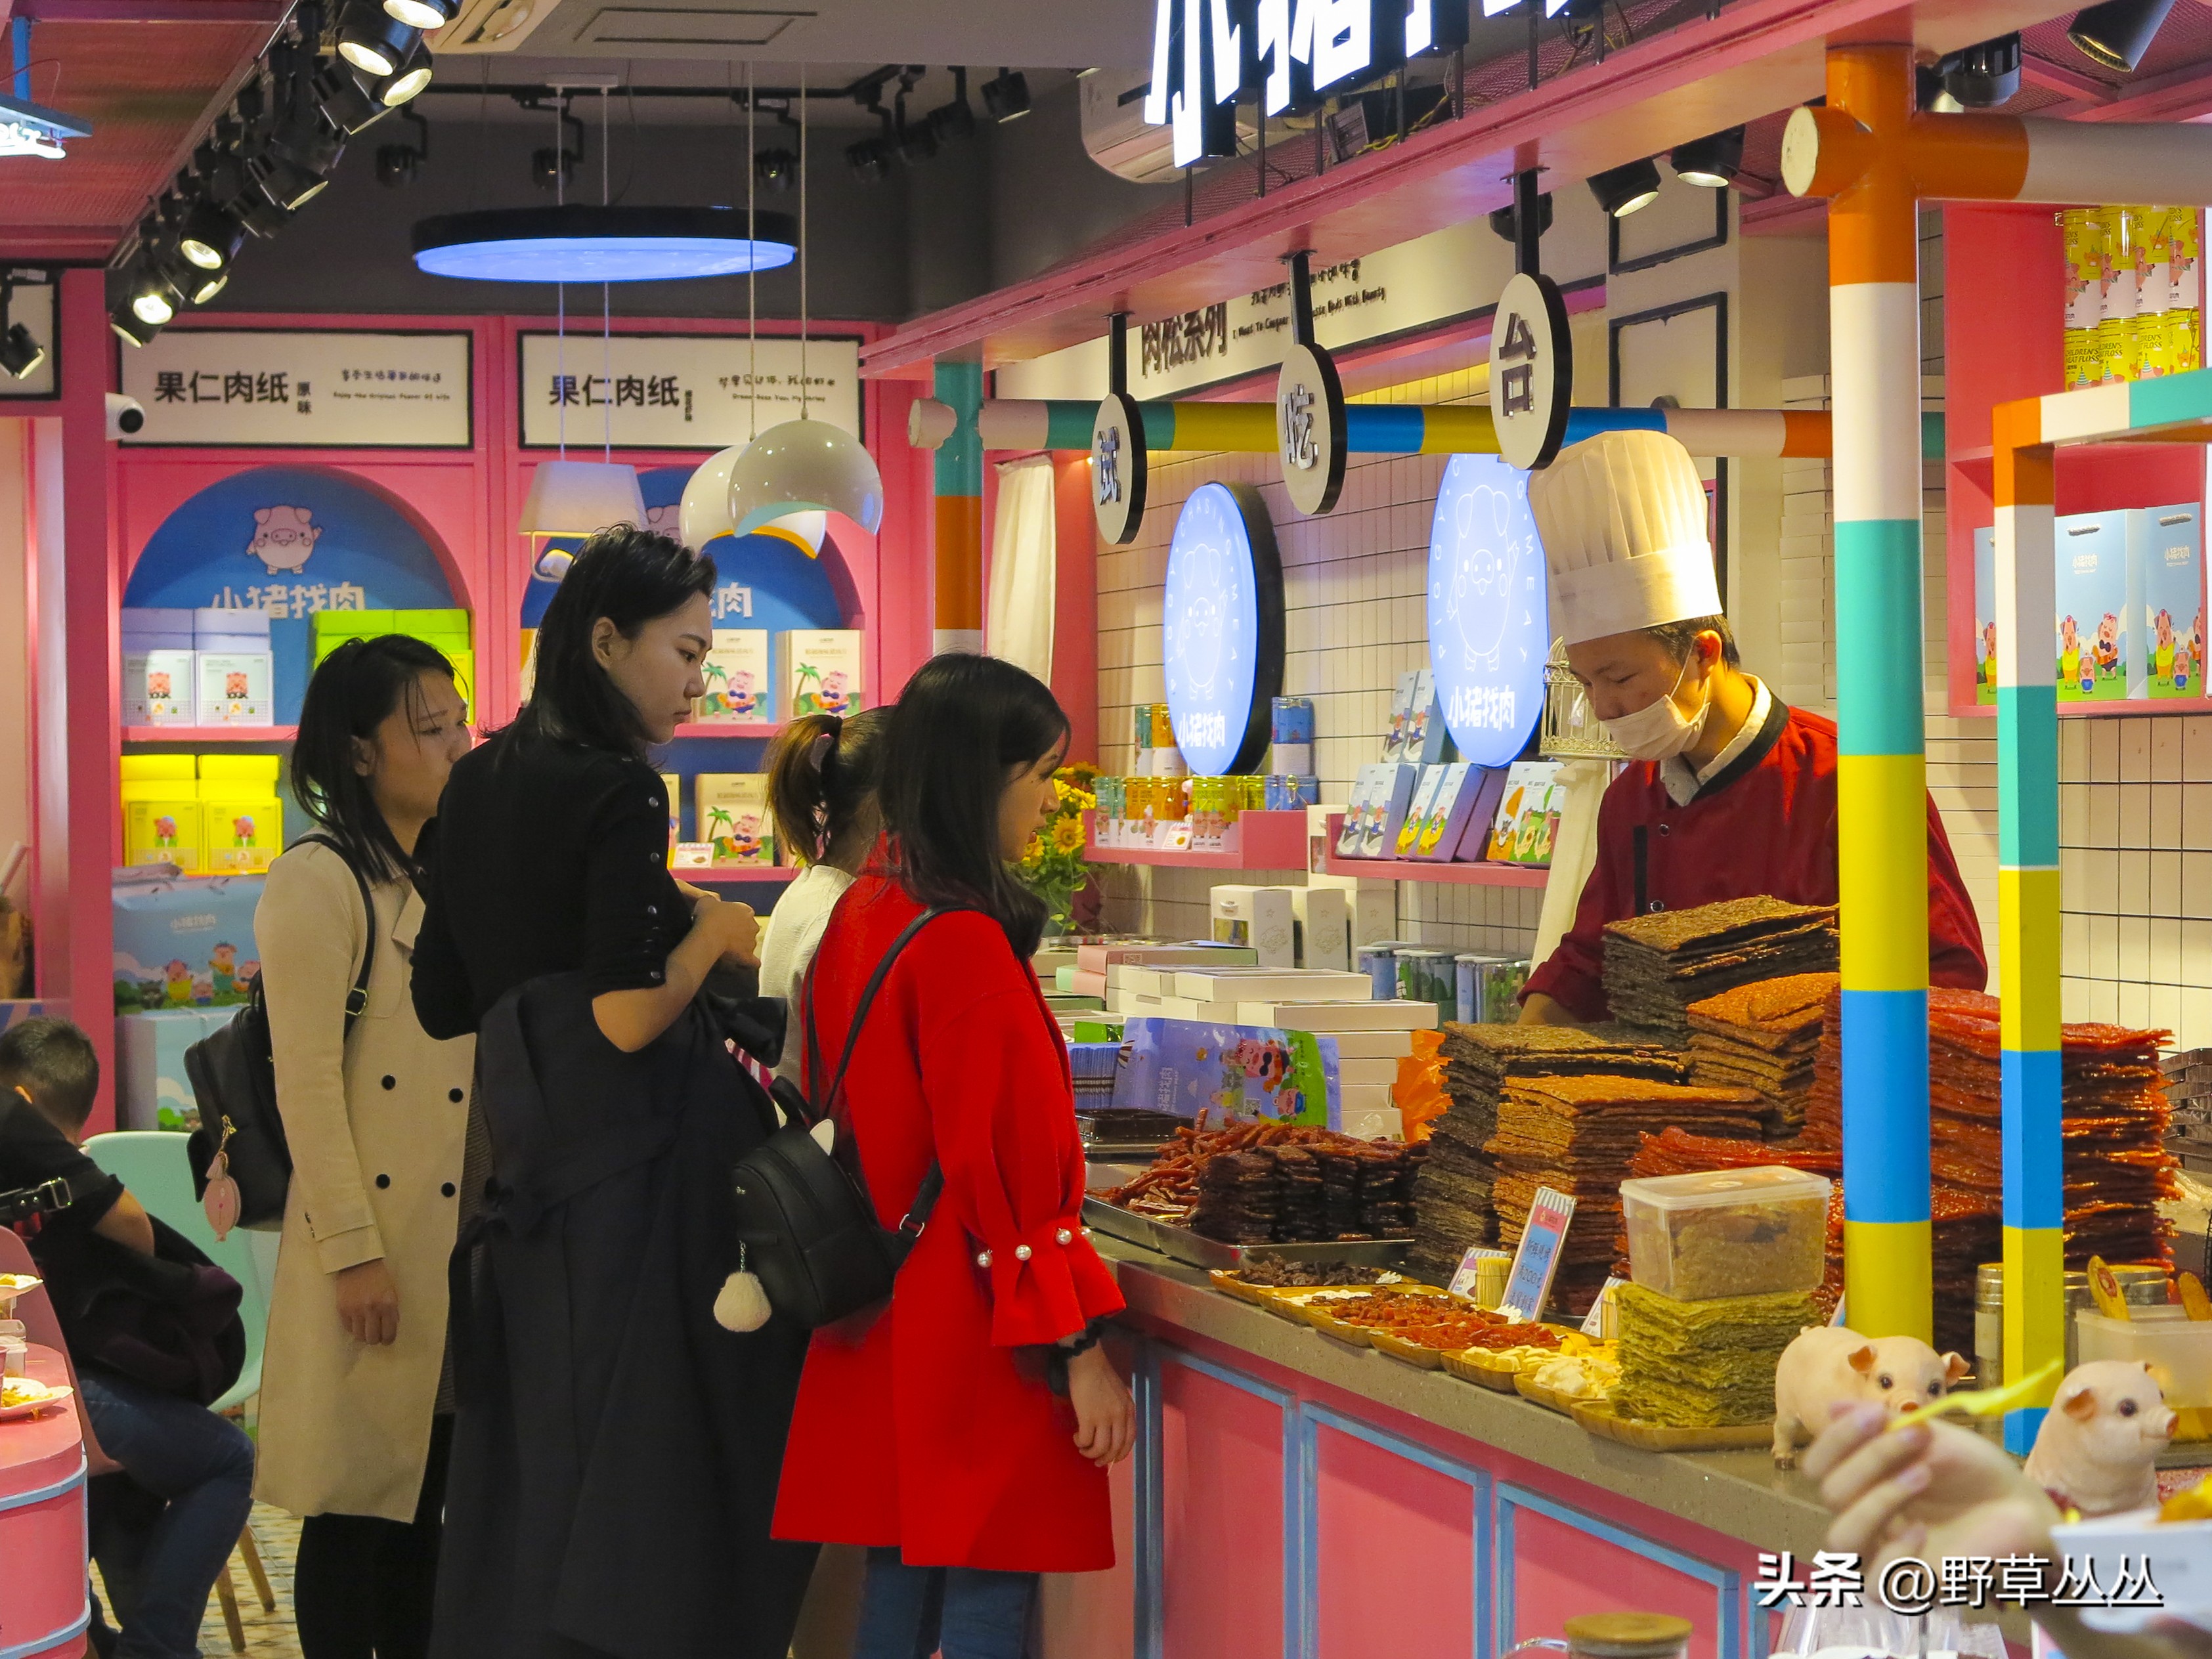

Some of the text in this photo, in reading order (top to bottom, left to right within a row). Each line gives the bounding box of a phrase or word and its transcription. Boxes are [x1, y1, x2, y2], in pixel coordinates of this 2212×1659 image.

[1498, 312, 1538, 418] 台
[154, 370, 289, 404] 果仁肉纸
[296, 381, 312, 415] 原味
[549, 374, 680, 407] 果仁肉纸
[1282, 383, 1319, 469] 吃
[1098, 427, 1121, 506] 试
[211, 582, 365, 618] 小猪找肉
[708, 582, 752, 620] 肉
[1447, 684, 1515, 732] 小猪找肉
[1178, 709, 1225, 749] 小猪找肉
